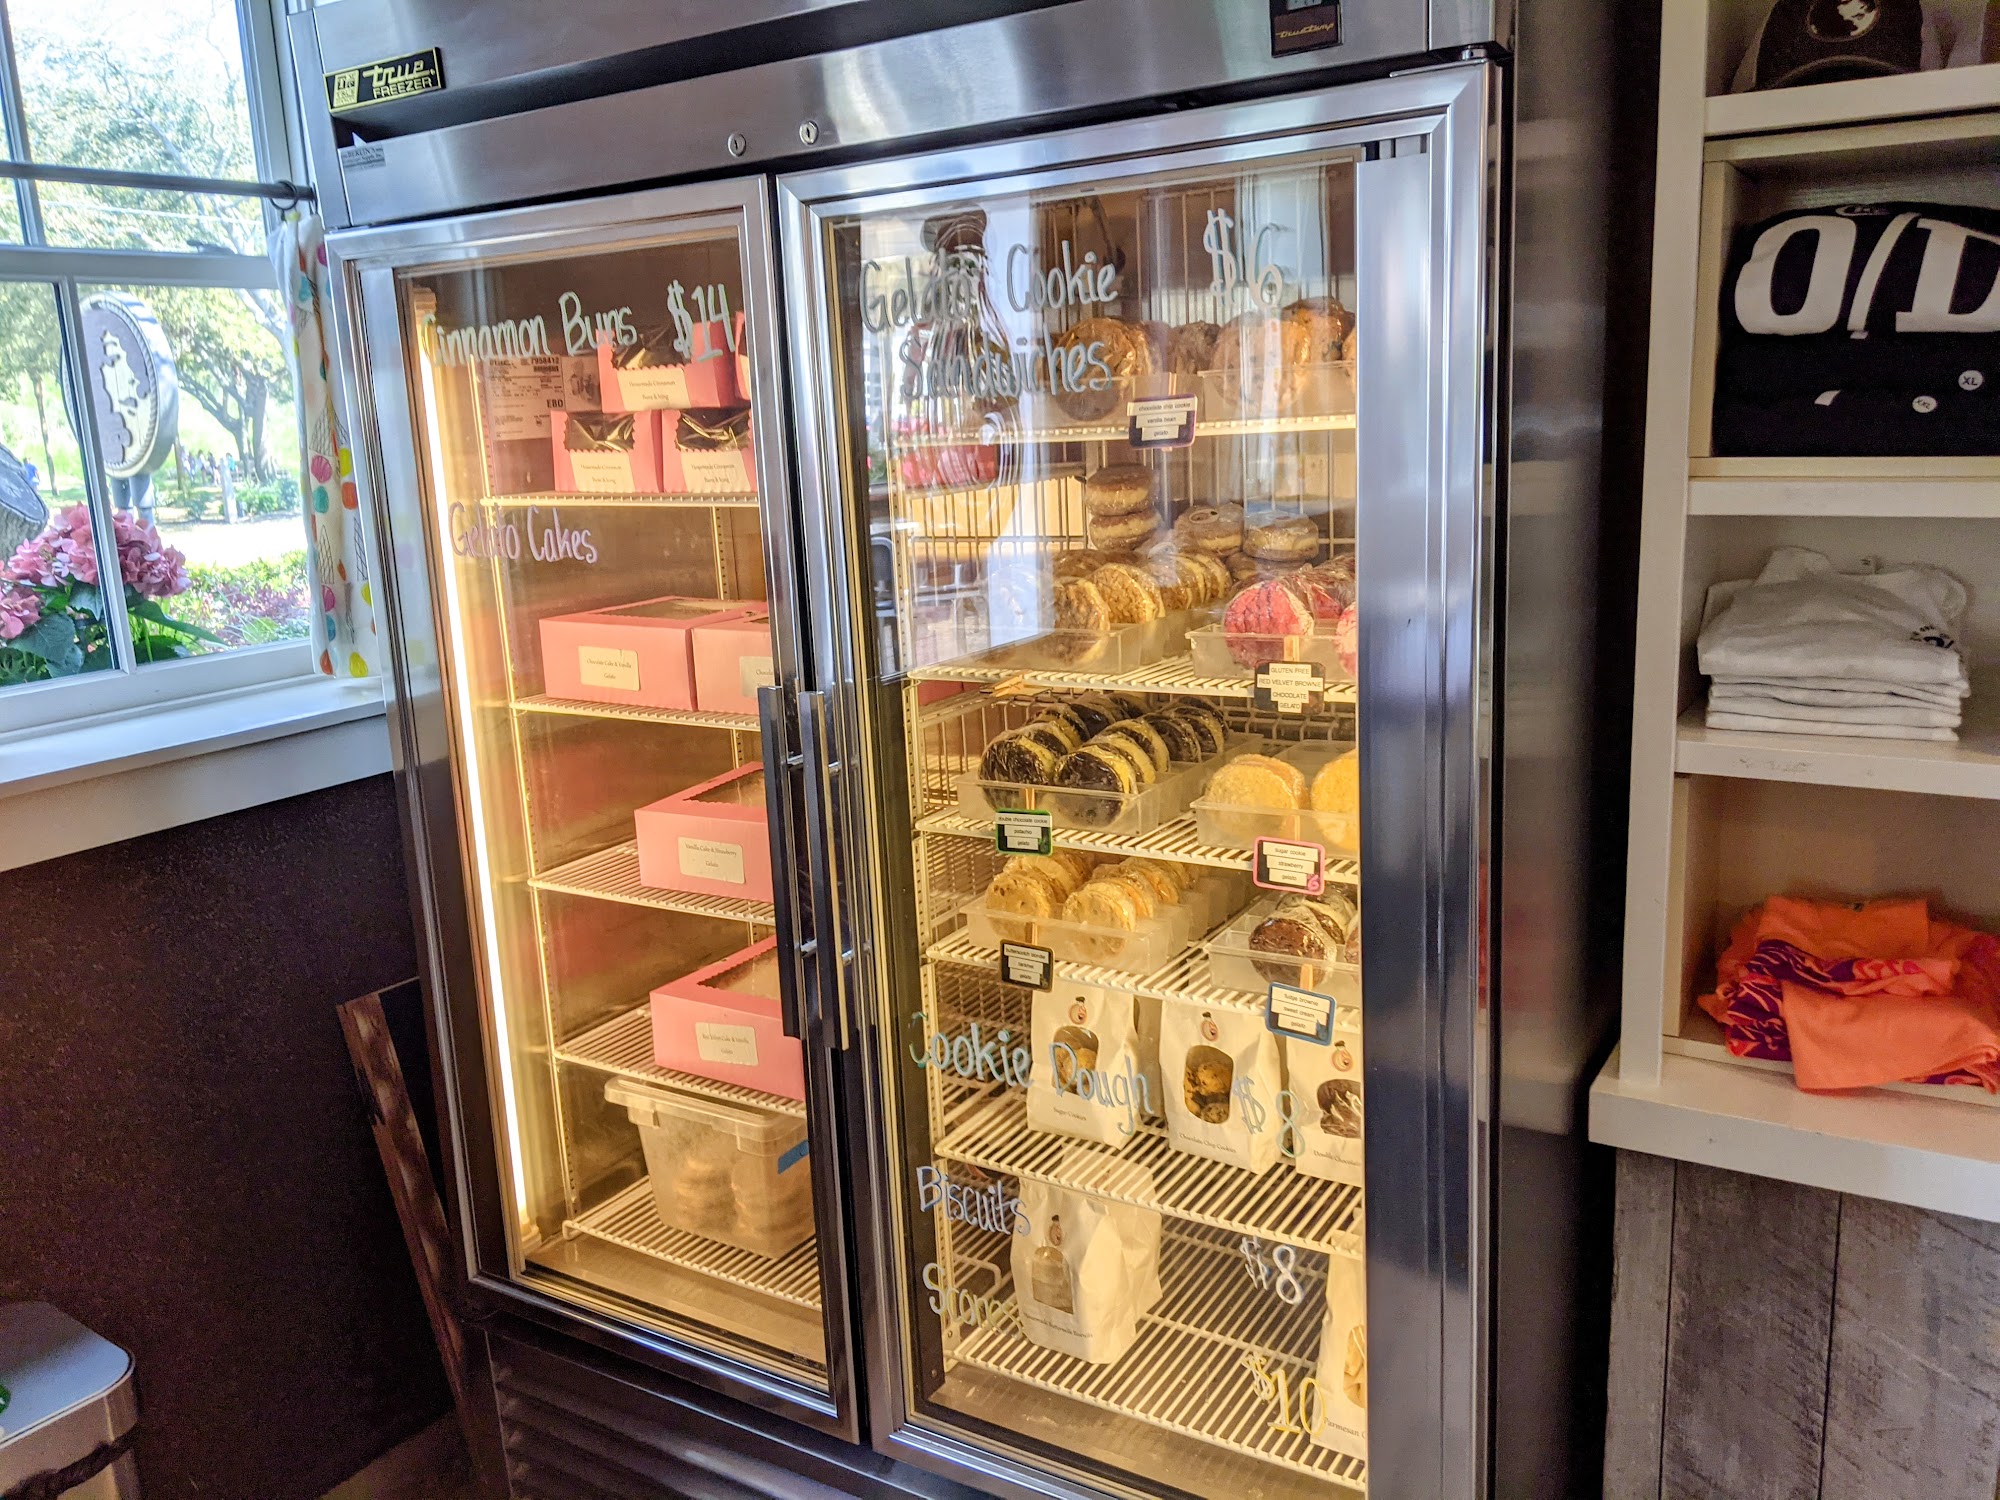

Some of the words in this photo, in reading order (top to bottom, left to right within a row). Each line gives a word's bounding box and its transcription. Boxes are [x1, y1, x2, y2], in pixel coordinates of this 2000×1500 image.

[373, 76, 433, 99] FREEZER
[860, 248, 972, 333] Gelato
[1007, 240, 1118, 313] Cookie
[421, 313, 551, 367] Cinnamon
[558, 291, 638, 356] Buns
[667, 279, 738, 362] $14
[900, 324, 1113, 399] Sandwiches
[1963, 376, 1978, 386] XL
[527, 503, 599, 565] Cakes
[1272, 691, 1308, 700] CHOCOLATE
[1279, 702, 1301, 710] GELATO
[1274, 847, 1288, 855] sugar
[1278, 861, 1304, 870] strawberry
[1281, 874, 1298, 882] gelato
[1283, 993, 1298, 1002] fudge
[1299, 997, 1319, 1007] brownie
[1283, 1006, 1299, 1014] sweet
[1299, 1010, 1315, 1018] cream
[1290, 1021, 1306, 1029] gelato
[1049, 1042, 1155, 1135] Dough
[916, 1165, 1031, 1236] Biscuits
[922, 1262, 1024, 1340] Scones
[1241, 1350, 1327, 1438] $10
[1323, 1416, 1360, 1437] Parmesan
